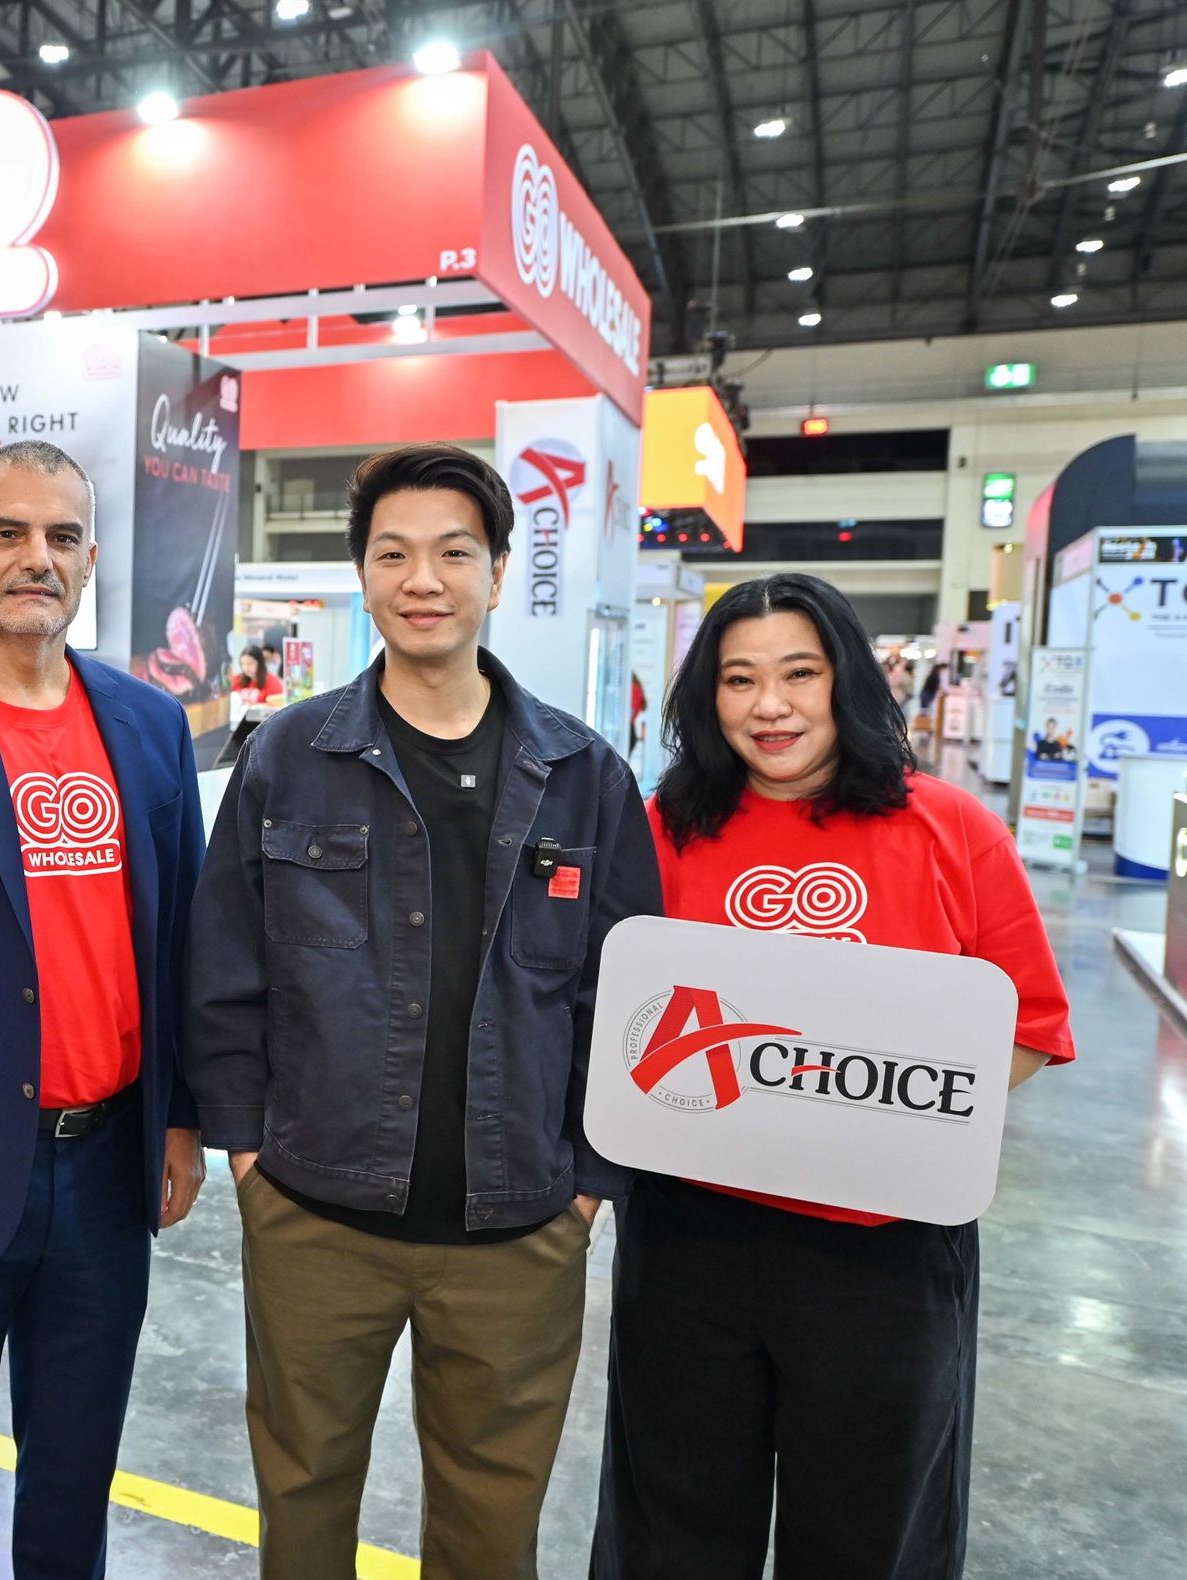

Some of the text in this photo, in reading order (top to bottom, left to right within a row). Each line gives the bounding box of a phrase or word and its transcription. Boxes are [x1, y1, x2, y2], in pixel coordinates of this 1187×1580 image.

[440, 248, 477, 272] P.3
[511, 143, 641, 378] GO WHOLESALE
[8, 412, 79, 434] RIGHT
[151, 393, 228, 474] Quality
[144, 456, 231, 494] YOU CAN TASTE
[530, 506, 560, 618] CHOICE
[10, 771, 120, 849] GO
[28, 848, 115, 868] WHOLESALE
[724, 861, 869, 934] GO
[629, 1001, 664, 1060] PROFESSIONAL
[664, 1093, 705, 1107] CHOICE
[749, 1041, 976, 1118] CHOICE
